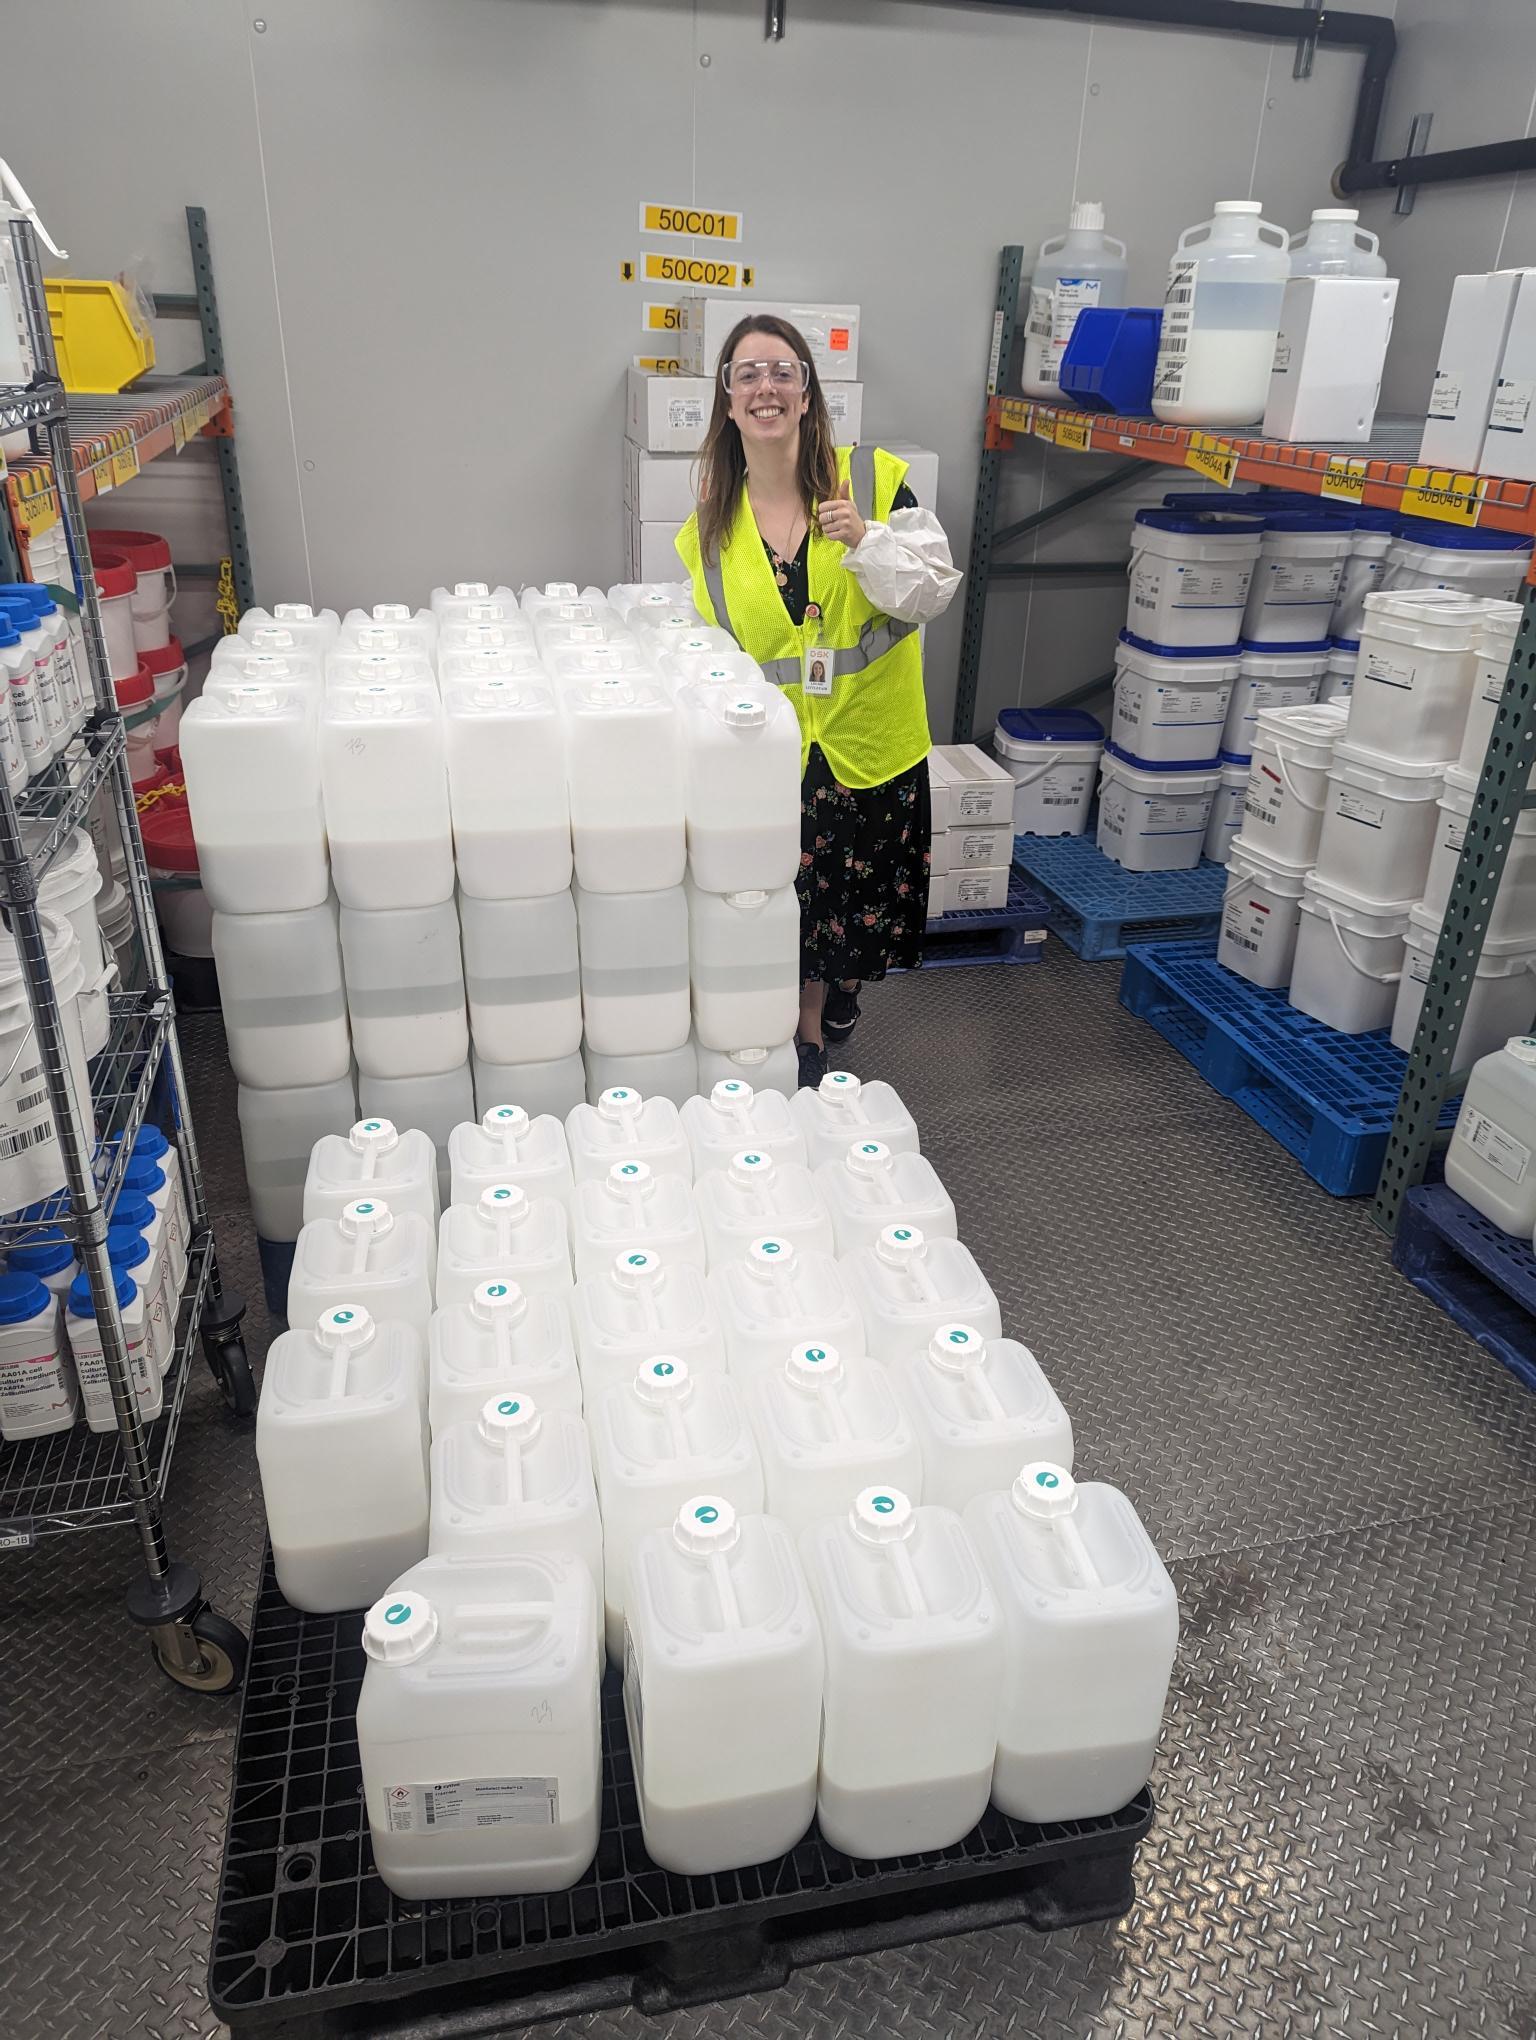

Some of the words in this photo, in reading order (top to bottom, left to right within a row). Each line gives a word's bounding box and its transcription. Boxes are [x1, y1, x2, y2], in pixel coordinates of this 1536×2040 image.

[659, 208, 725, 237] 50C01
[661, 258, 729, 286] 50C02
[1326, 467, 1366, 491] 50A04
[1417, 485, 1463, 508] 50B04B
[29, 1366, 43, 1374] cell
[80, 1359, 104, 1367] FAA01
[26, 1370, 56, 1381] medium
